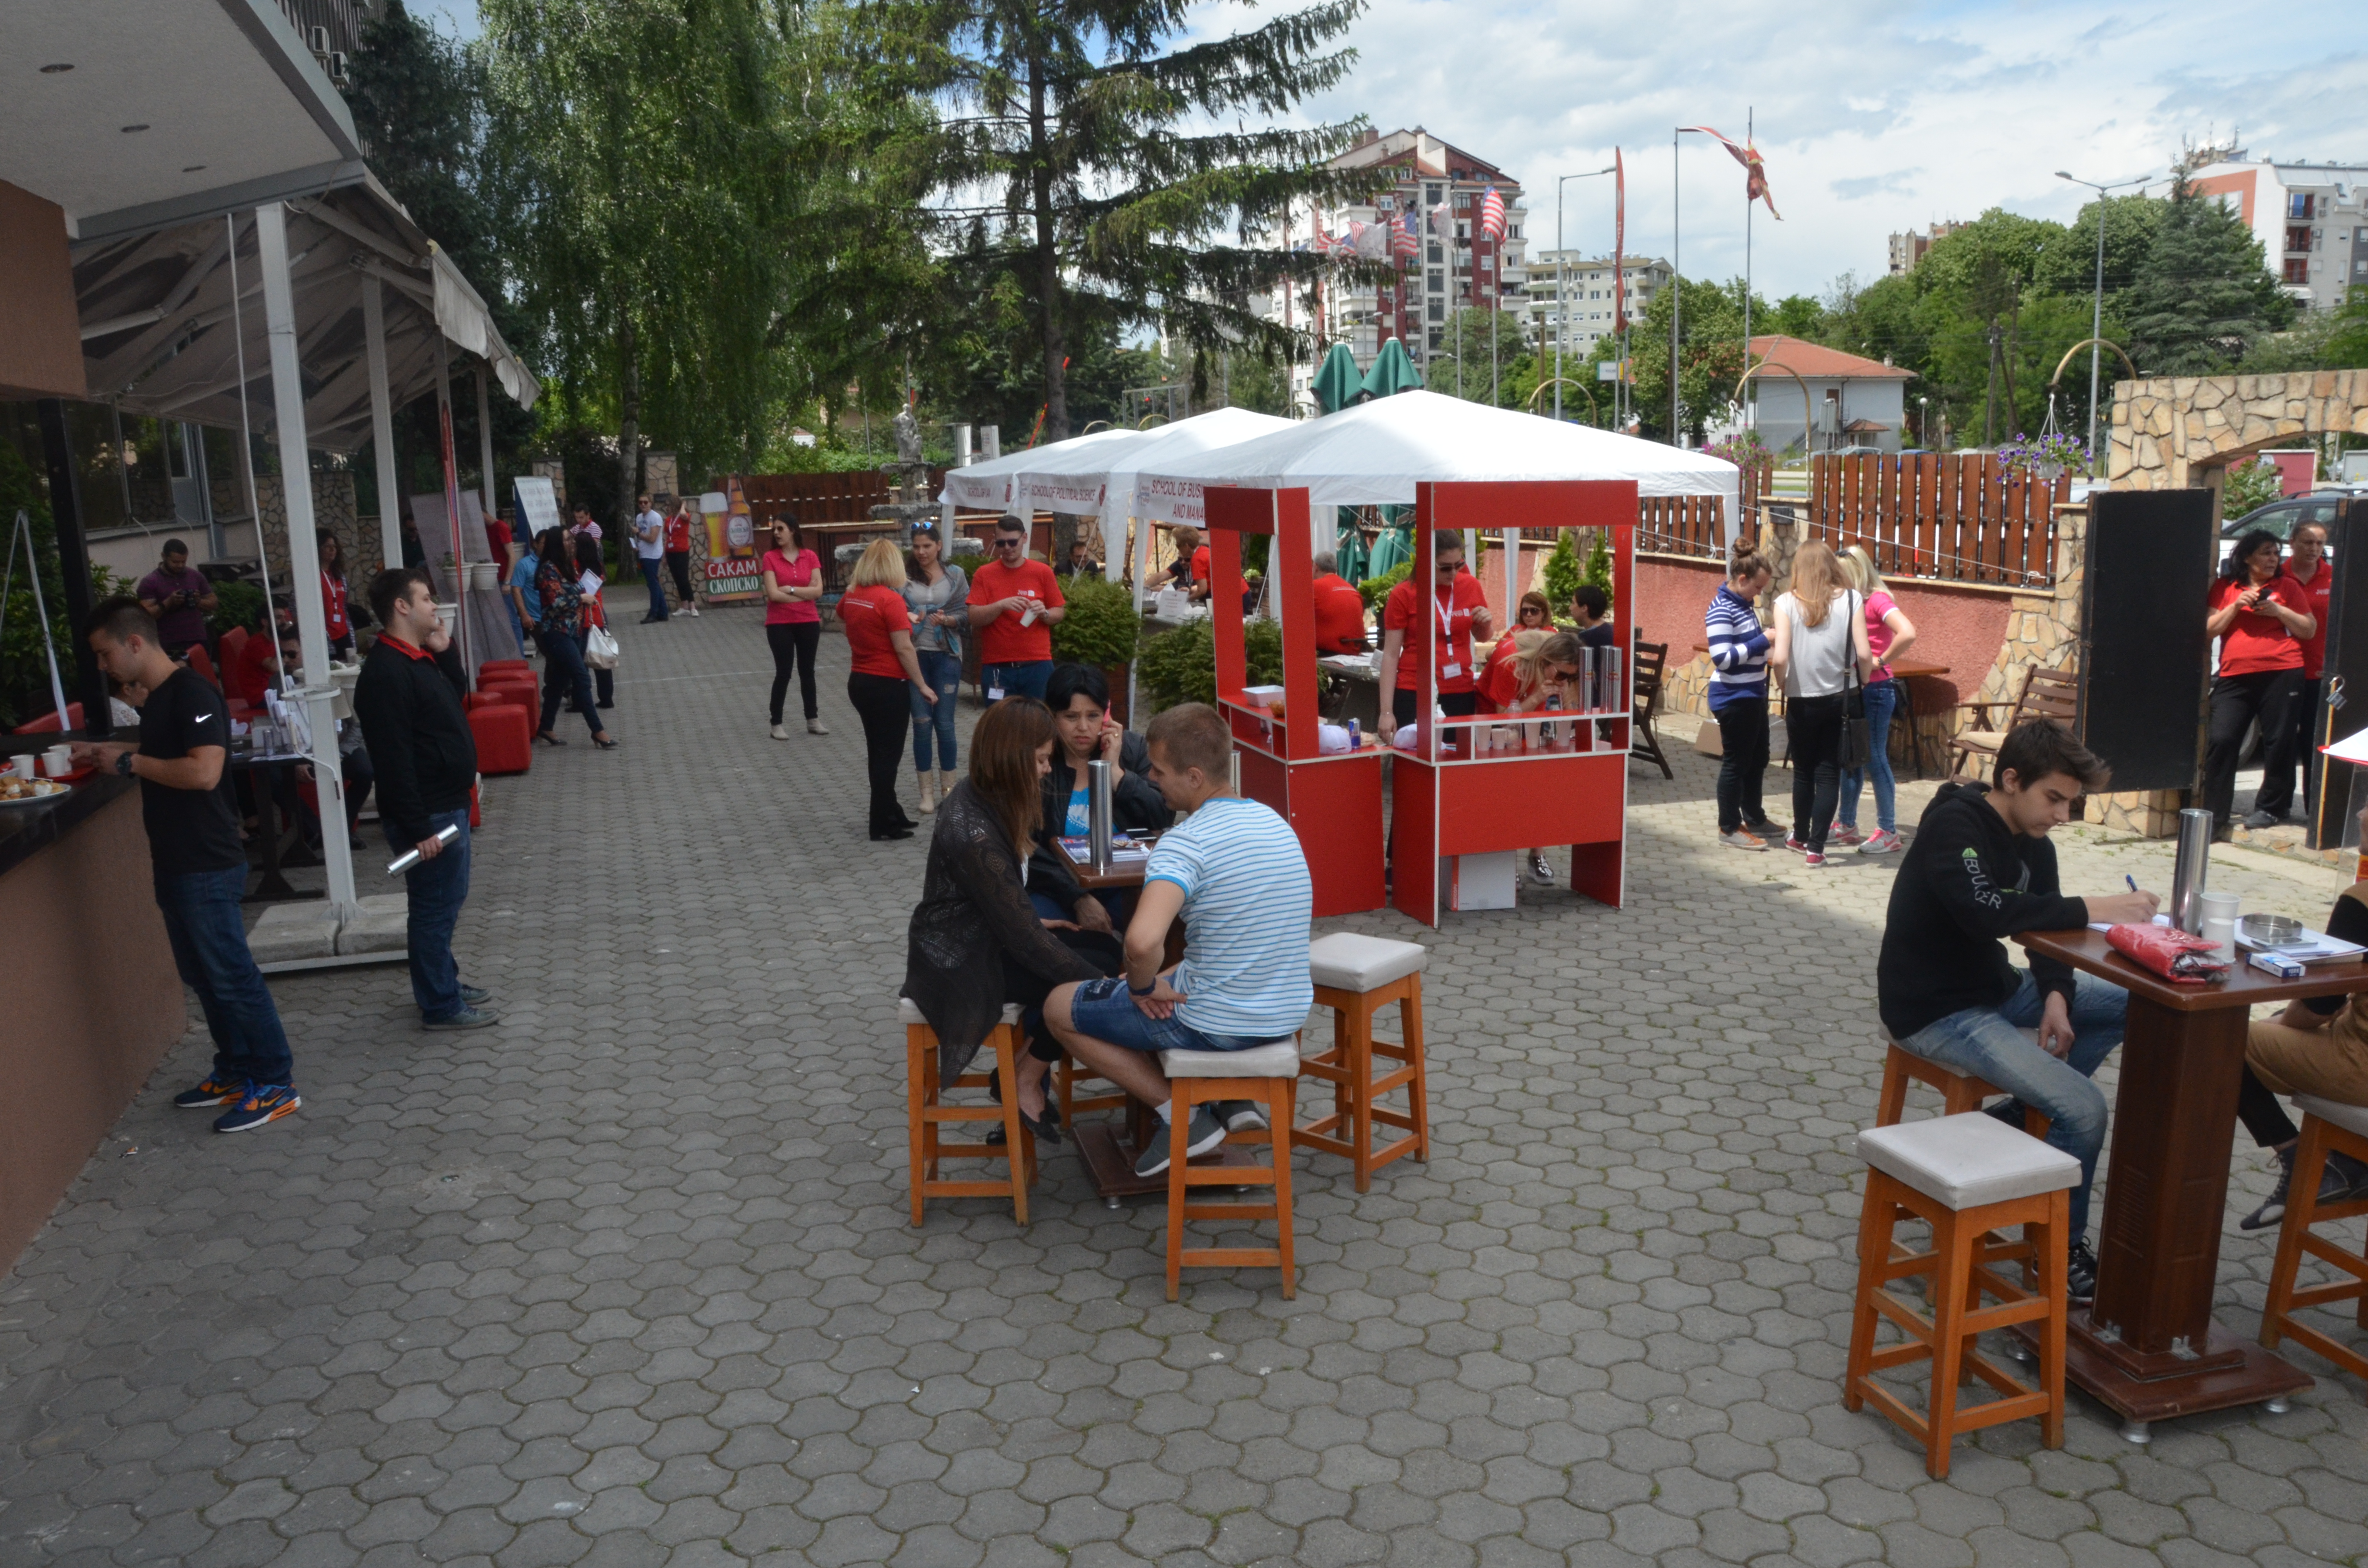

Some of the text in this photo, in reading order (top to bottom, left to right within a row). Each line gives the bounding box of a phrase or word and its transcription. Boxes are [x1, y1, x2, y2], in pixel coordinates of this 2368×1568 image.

[1032, 485, 1048, 497] SCHOOL
[1049, 486, 1057, 498] OF
[1056, 487, 1079, 501] POLITICAL
[1152, 479, 1176, 496] SCHOOL
[1177, 482, 1187, 497] OF
[1172, 503, 1206, 521] AND MANA
[708, 560, 757, 577] САКАМ
[709, 576, 759, 594] СКОПСКО
